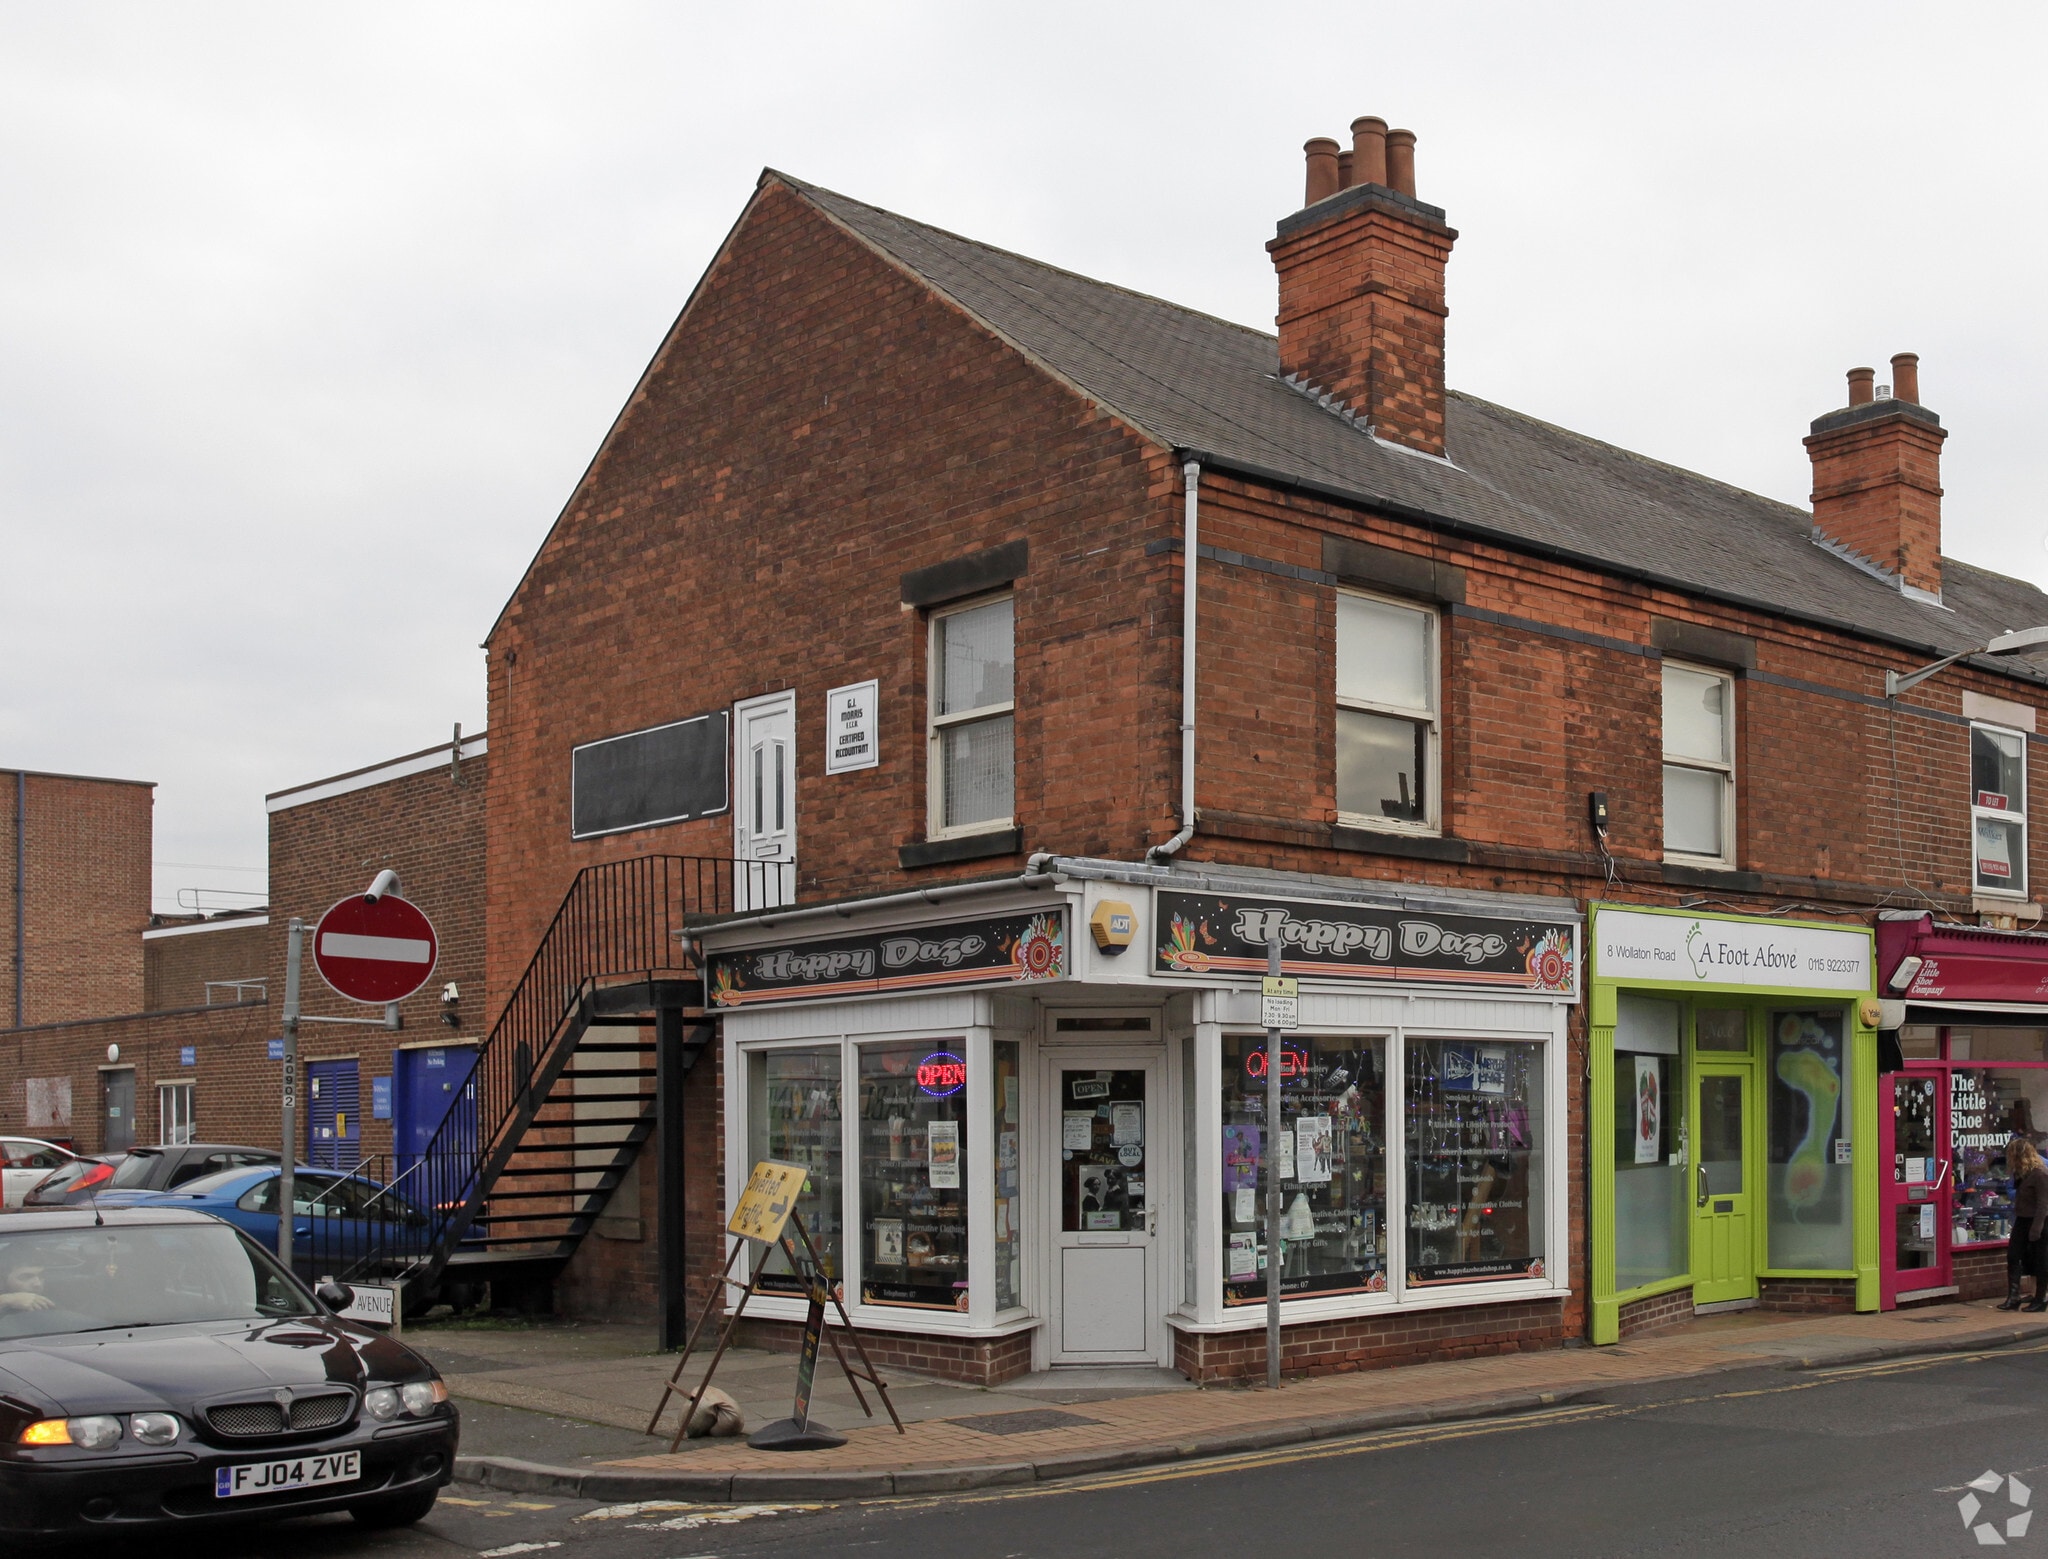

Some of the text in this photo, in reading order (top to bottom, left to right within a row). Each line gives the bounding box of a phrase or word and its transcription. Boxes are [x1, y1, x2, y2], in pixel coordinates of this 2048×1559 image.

[841, 708, 863, 722] MORRIS
[839, 731, 865, 746] CERTIFIED
[835, 743, 869, 759] ACCOUNTANT
[1111, 918, 1130, 930] ADT
[1232, 907, 1507, 964] Happy Daze
[755, 934, 986, 981] Happy Daze
[1607, 945, 1676, 961] 8 Wollaton Road
[1698, 942, 1798, 969] A Foot Above
[1808, 957, 1860, 973] 0115 9223377
[1924, 959, 1938, 969] The
[1919, 968, 1940, 977] Little
[1915, 977, 1934, 986] Shoe
[1911, 986, 1946, 996] Company
[1275, 998, 1293, 1006] loading
[1868, 1009, 1881, 1019] Yale
[1246, 1052, 1308, 1076] OEN
[917, 1064, 967, 1086] OPEN
[1951, 1073, 1975, 1093] The
[1077, 1083, 1104, 1094] OPEN
[1951, 1093, 1986, 1111] Little
[1951, 1112, 1982, 1130] Shoe
[1951, 1130, 2012, 1151] Company
[1894, 1168, 1900, 1181] 6
[748, 1171, 781, 1197] Diverted
[1306, 1180, 1327, 1189] Goods
[738, 1202, 762, 1225] traffic
[907, 1222, 939, 1233] Alternative
[940, 1223, 966, 1234] Clothing
[1469, 1229, 1480, 1238] Age
[1481, 1228, 1495, 1236] Gifts
[1312, 1239, 1328, 1247] Gifts
[357, 1295, 392, 1313] AVENUE
[234, 1453, 358, 1491] FJ04 ZVE
